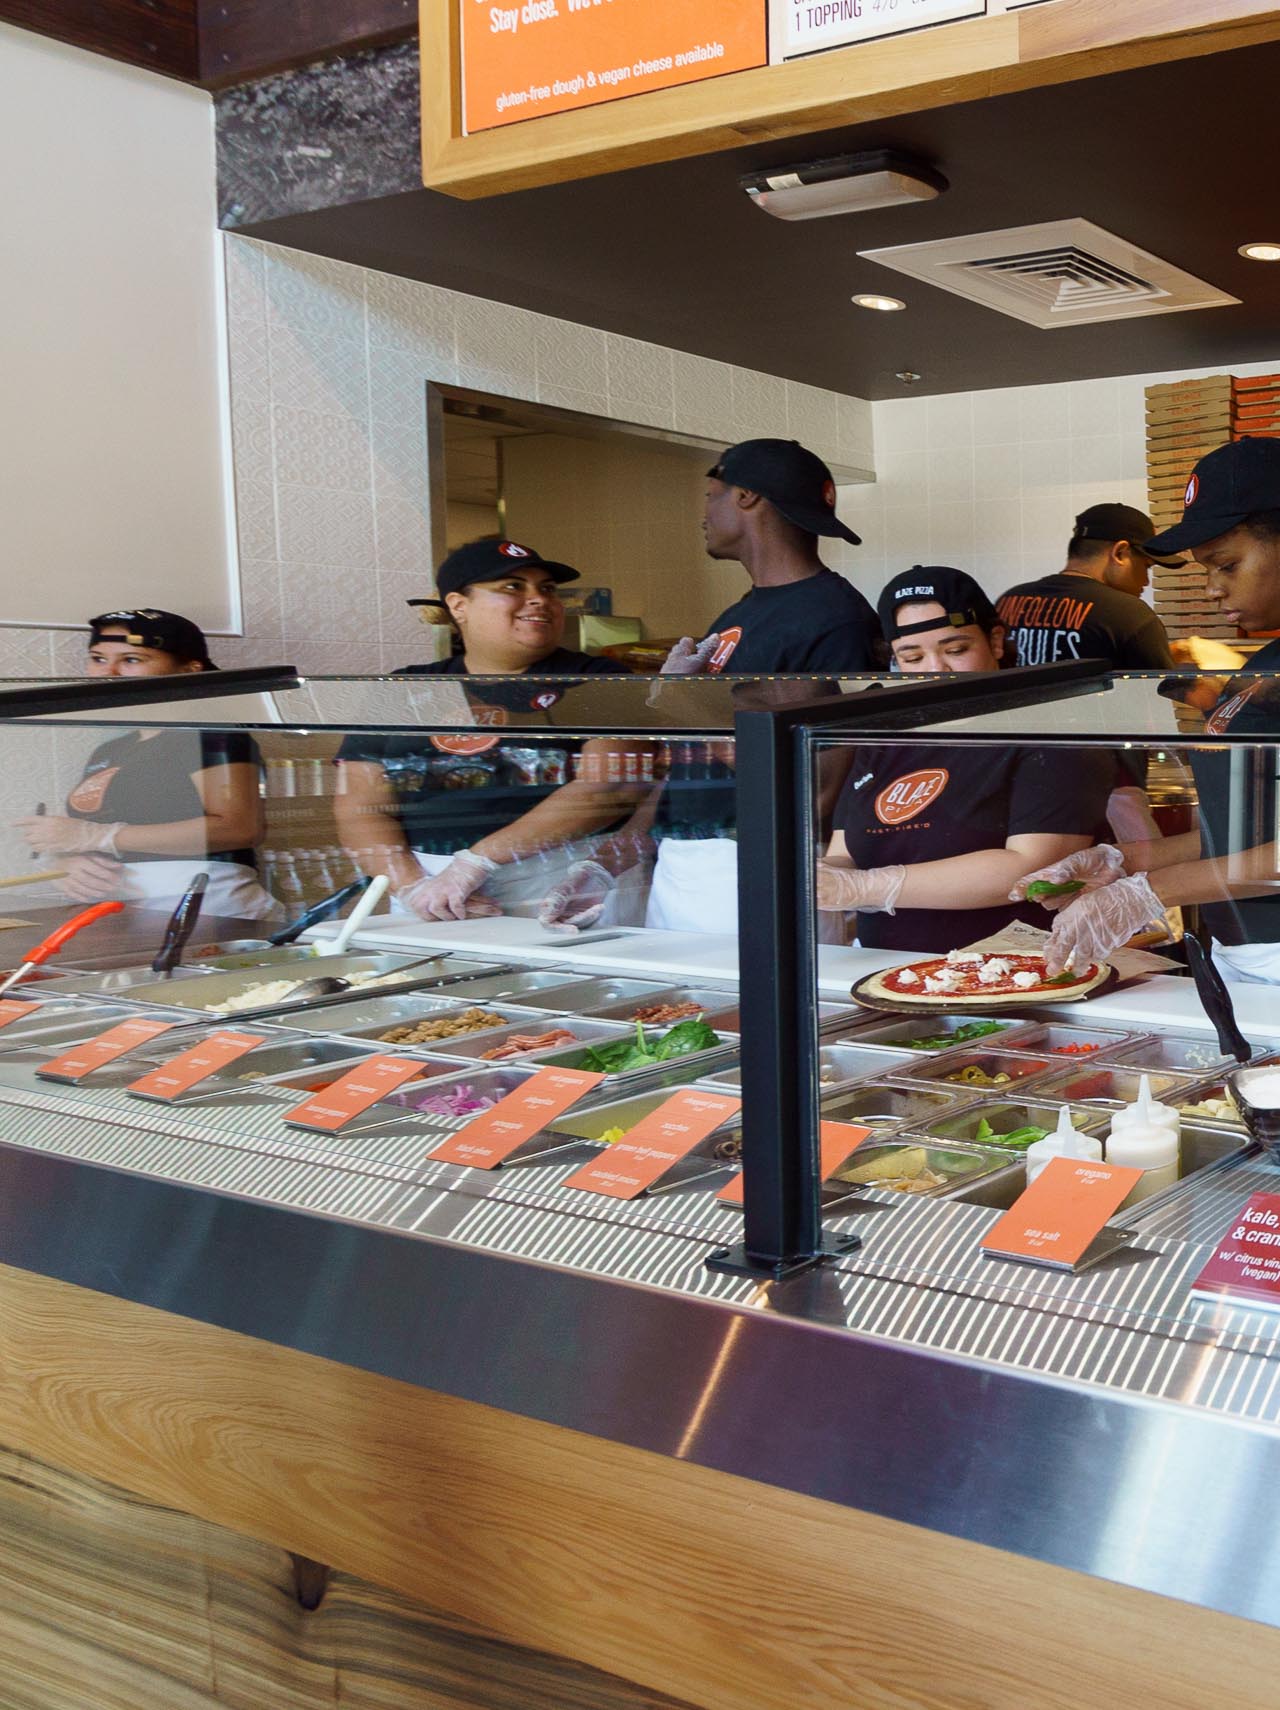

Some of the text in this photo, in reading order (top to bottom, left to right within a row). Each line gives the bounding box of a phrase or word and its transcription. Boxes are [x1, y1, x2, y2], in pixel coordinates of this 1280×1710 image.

[490, 8, 518, 33] Stay
[521, 0, 559, 25] close.
[807, 0, 862, 29] TOPPING
[496, 42, 725, 112] gluten-free dough & vegan cheese available
[998, 595, 1094, 630] UNFOLLOW
[1015, 628, 1081, 667] RULES
[1241, 1206, 1280, 1229] kale,
[1023, 1228, 1061, 1242] sea salt
[1232, 1226, 1246, 1242] &
[1219, 1249, 1233, 1262] w/
[1234, 1253, 1263, 1268] citrus
[1241, 1265, 1280, 1282] (vegan)
